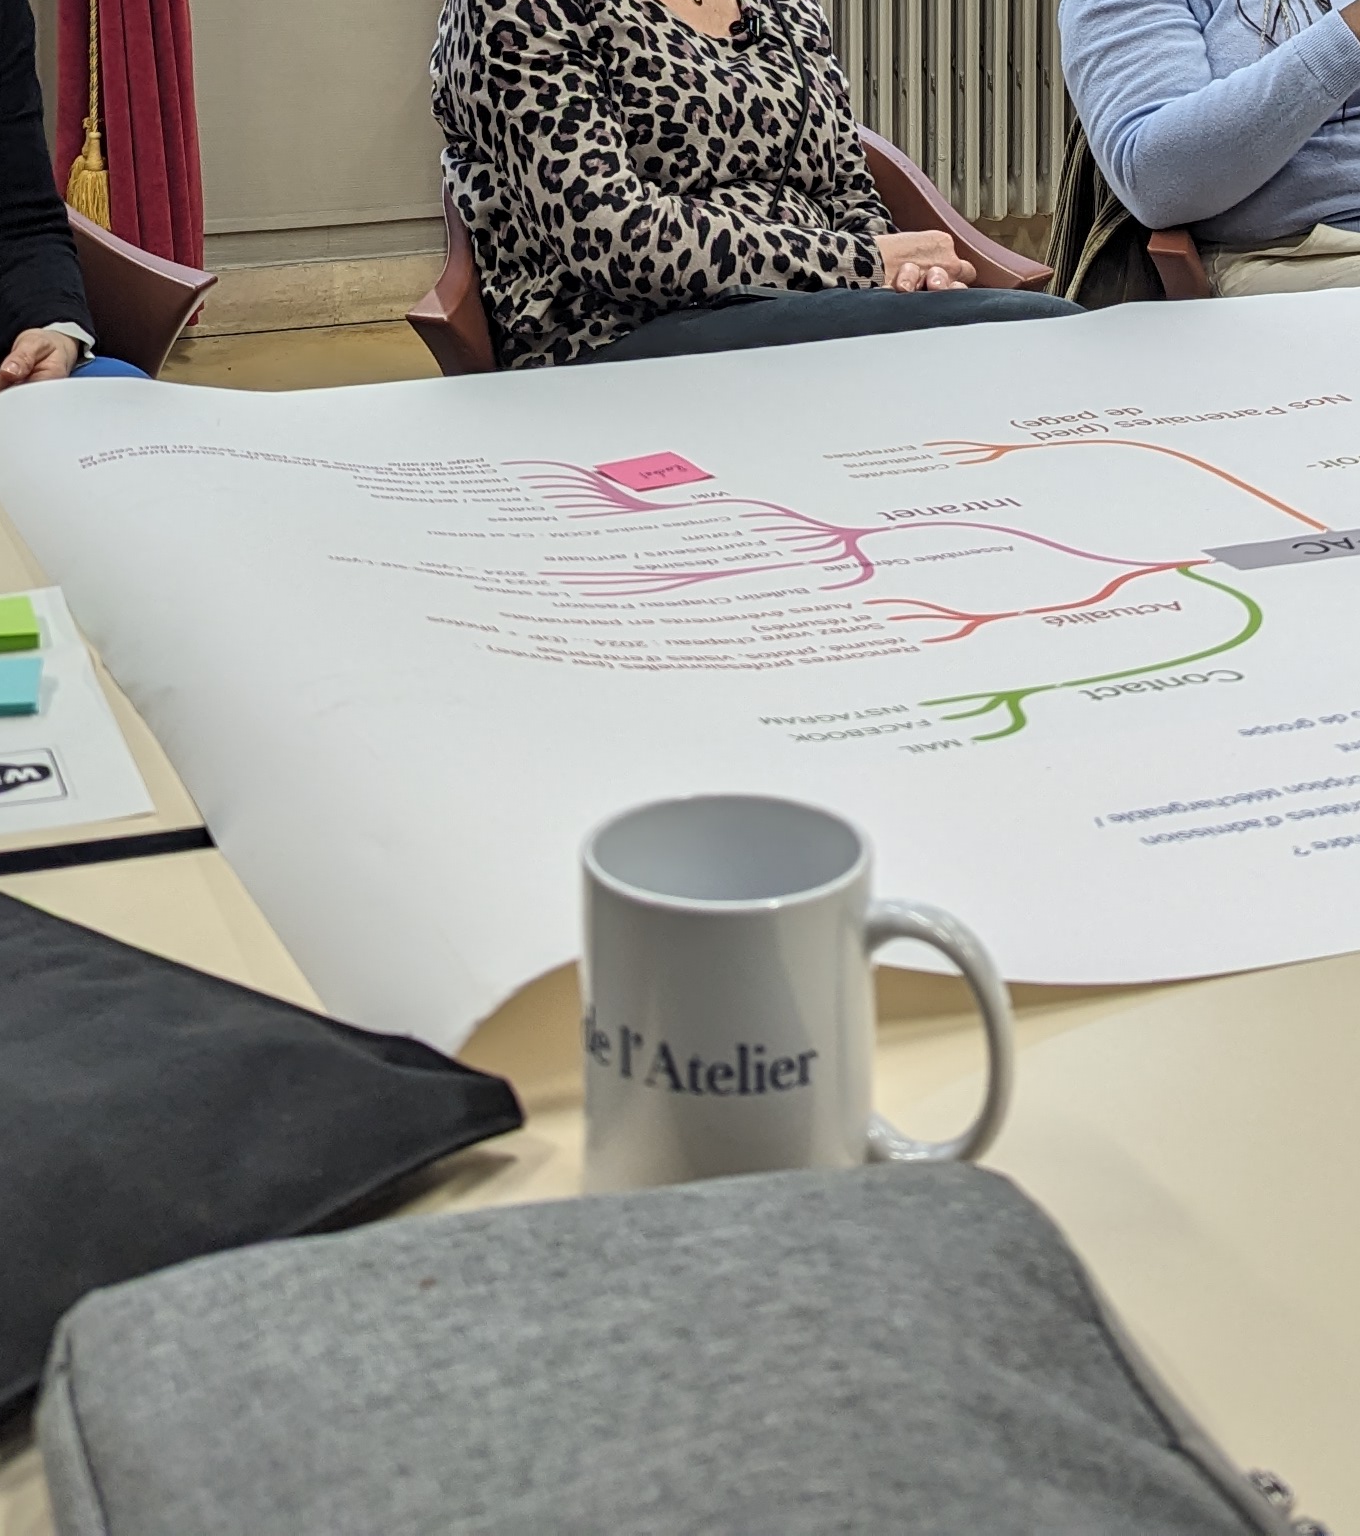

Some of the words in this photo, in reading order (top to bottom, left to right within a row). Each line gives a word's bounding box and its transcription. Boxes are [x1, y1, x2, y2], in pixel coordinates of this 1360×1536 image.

[1288, 394, 1352, 410] Nos
[1010, 410, 1104, 430] page)
[1104, 408, 1144, 416] de
[1114, 406, 1288, 428] Partenaires
[1026, 422, 1110, 442] (pied
[822, 444, 918, 460] Entreprises
[842, 454, 934, 468] Institutions
[848, 464, 950, 478] Collectivités
[690, 490, 732, 500] Wiki
[876, 498, 1024, 522] Intranet
[680, 530, 744, 542] Forum
[1040, 600, 1182, 628] Actualité
[1078, 670, 1246, 702] Contact
[758, 704, 910, 726] INSTAGRAM
[1318, 714, 1350, 724] de
[788, 718, 932, 742] FACEBOOK
[1238, 718, 1316, 736] groupe
[898, 738, 964, 754] MAIL
[1140, 816, 1284, 846] d'admission
[619, 1024, 818, 1096] l'Atelier
